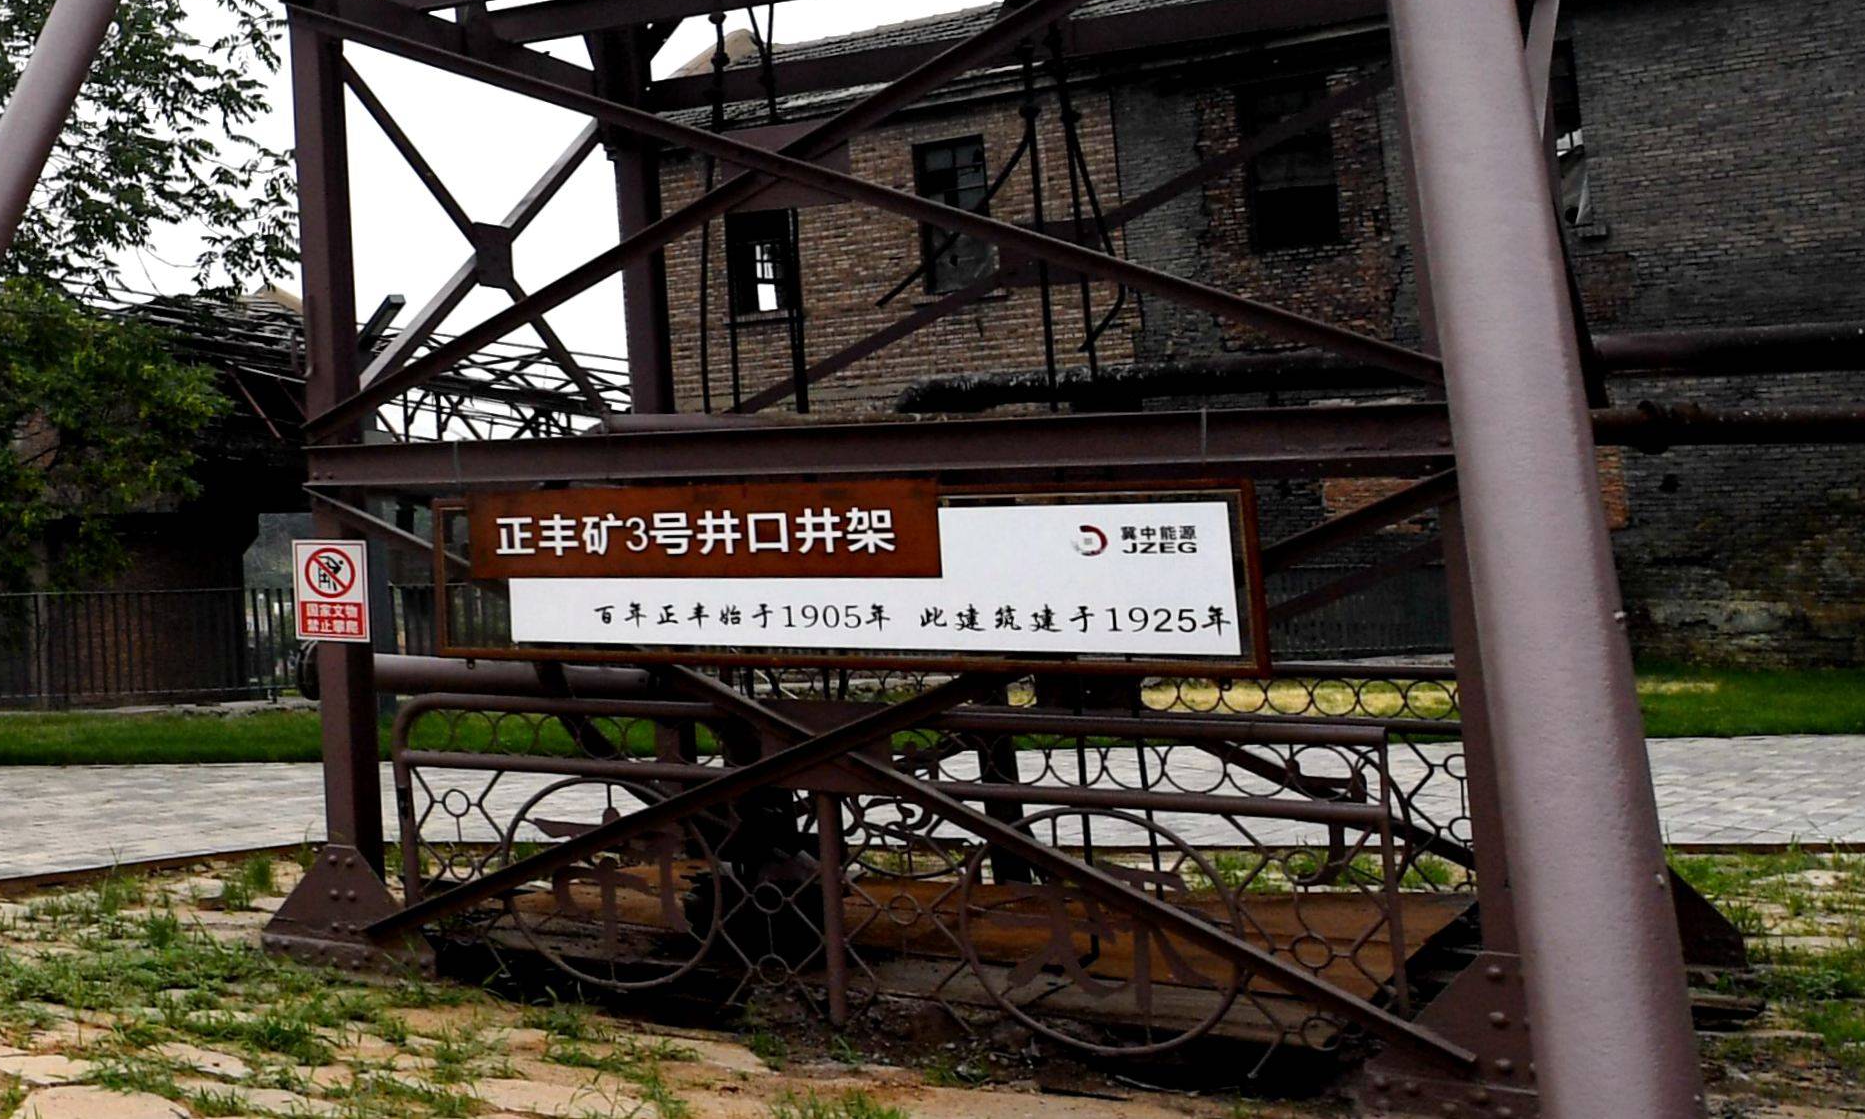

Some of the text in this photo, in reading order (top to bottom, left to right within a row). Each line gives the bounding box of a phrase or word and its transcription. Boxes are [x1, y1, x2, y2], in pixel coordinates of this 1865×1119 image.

[496, 507, 895, 557] 正丰矿3号井口井架
[1121, 525, 1197, 541] 冀中能源
[1123, 542, 1197, 554] JZEG
[594, 602, 1232, 636] 百年正丰始于1905年 此建筑建于1925年
